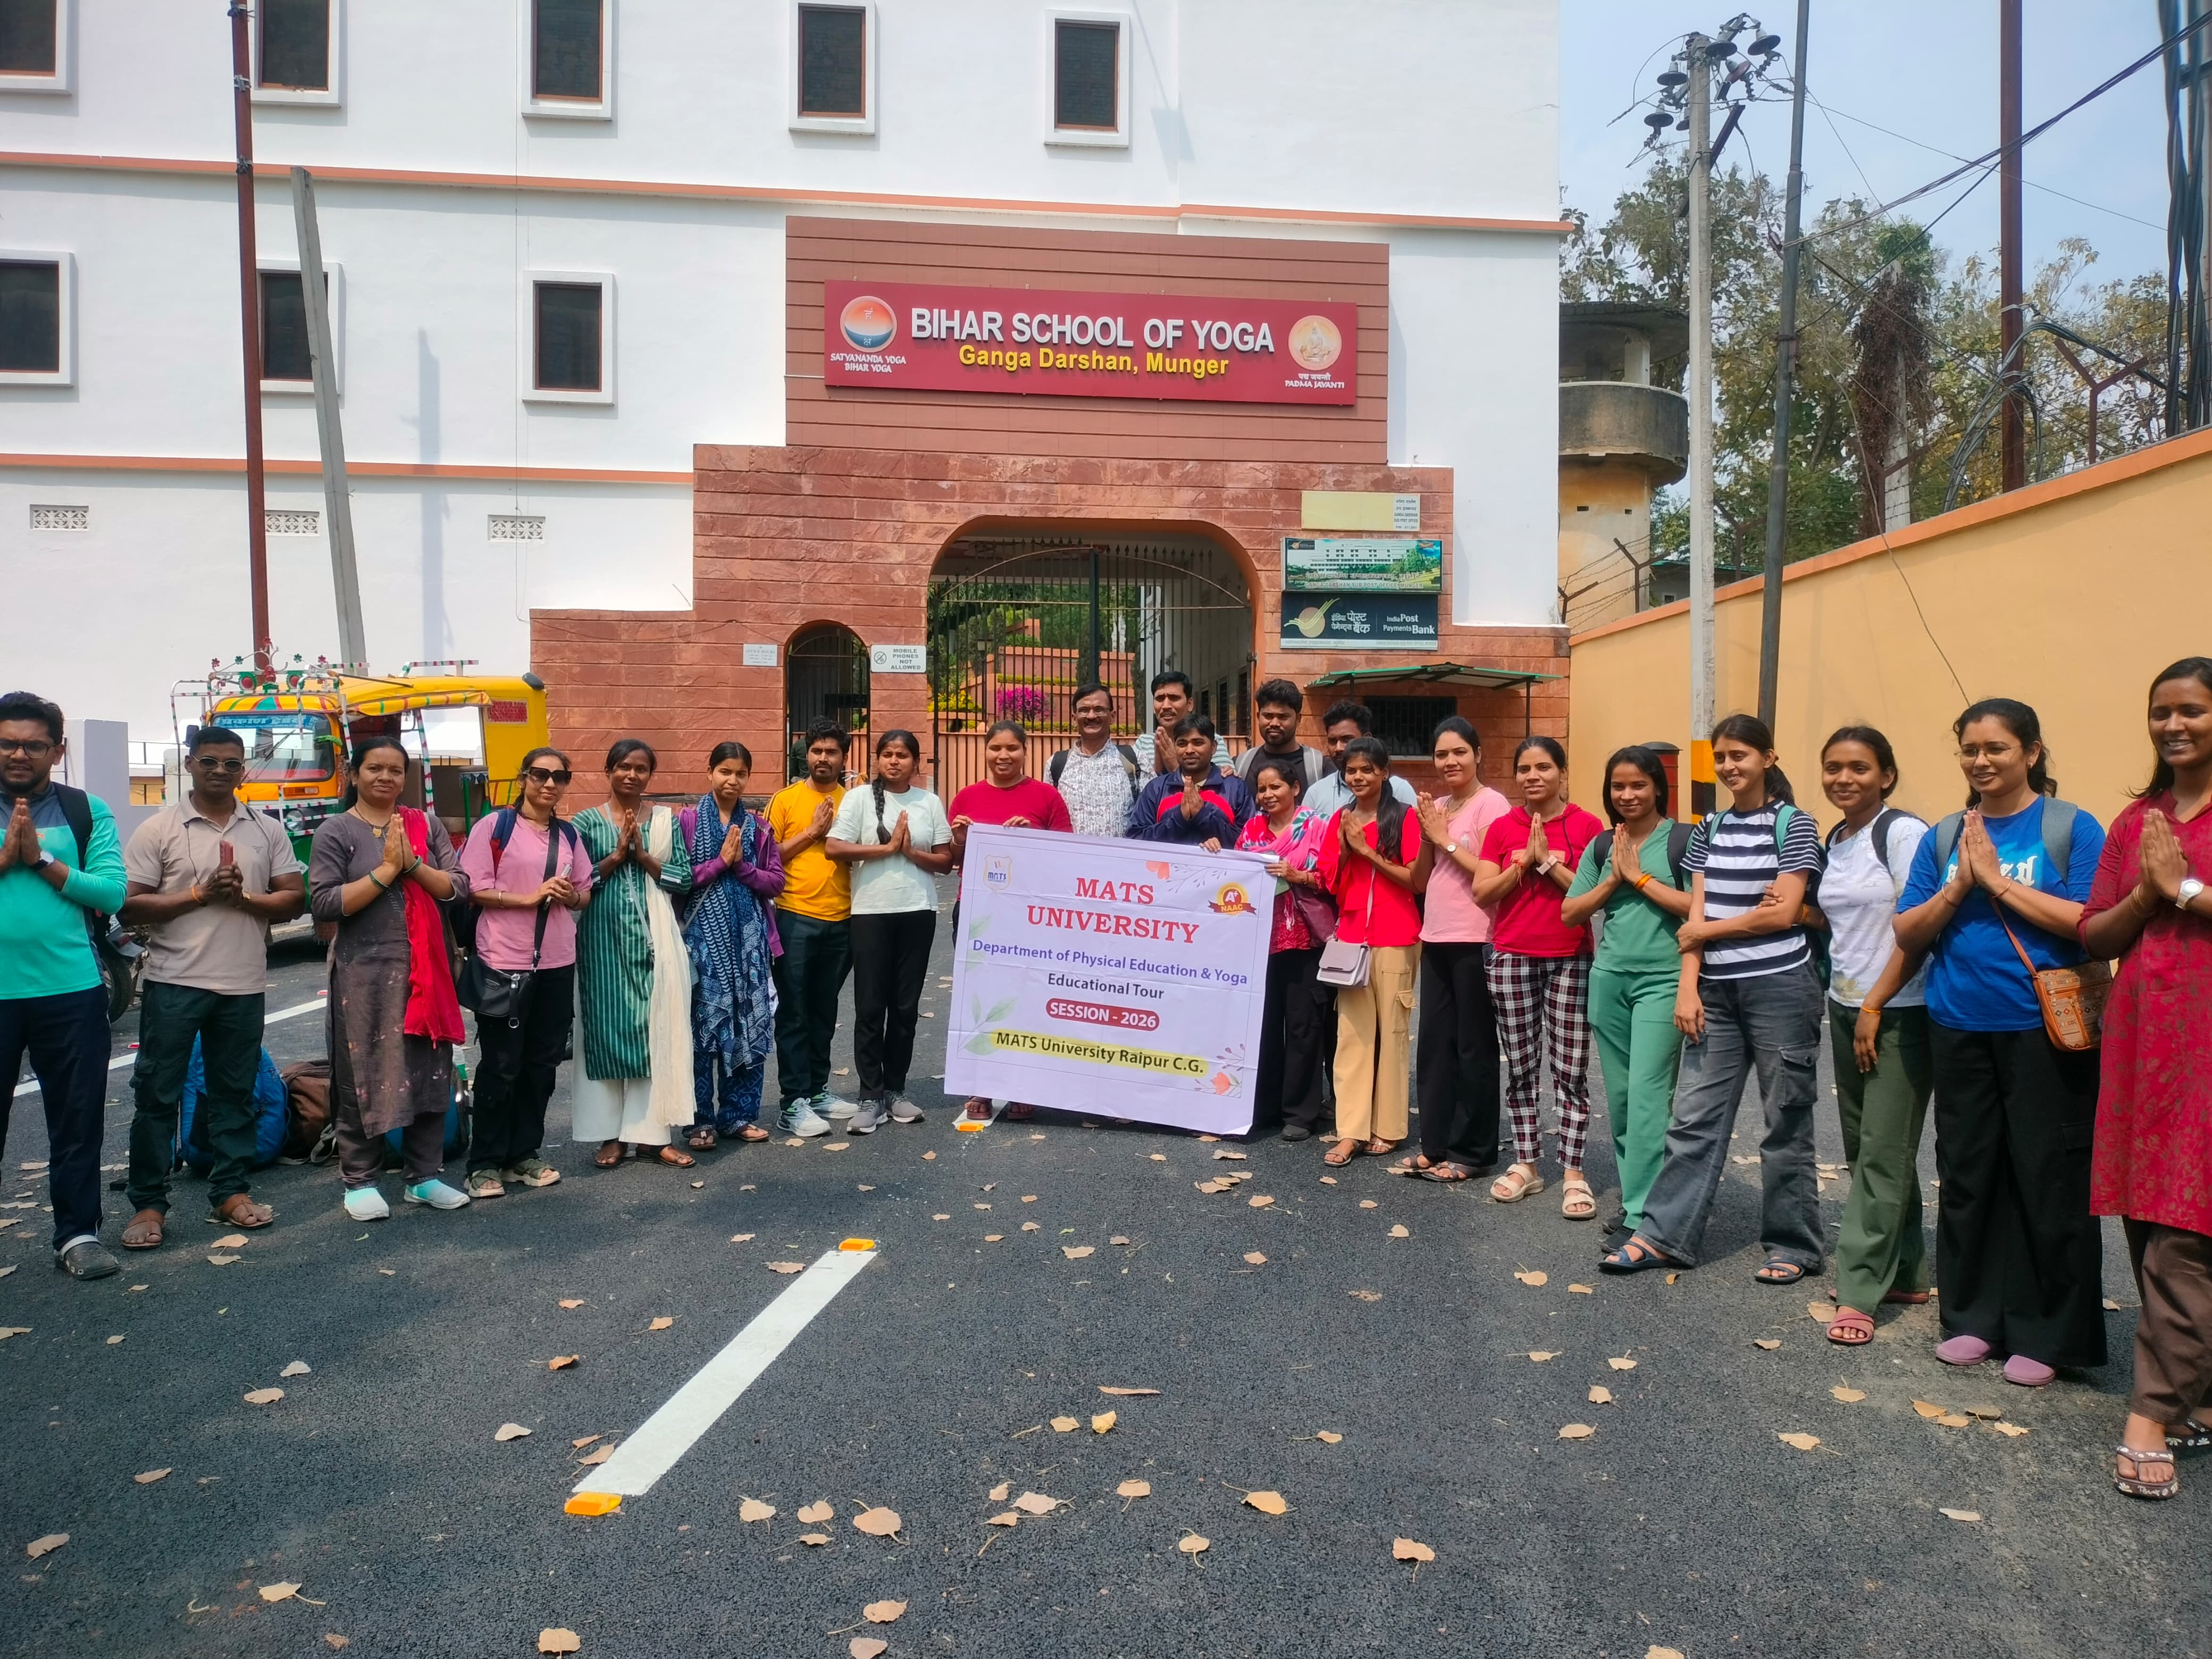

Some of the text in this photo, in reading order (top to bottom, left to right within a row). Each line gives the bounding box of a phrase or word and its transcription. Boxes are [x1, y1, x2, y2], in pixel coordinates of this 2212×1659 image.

[911, 308, 1275, 353] BIHAR SCHOOL OF YOGA
[830, 353, 907, 365] SATYANANDA YOGA
[844, 363, 892, 373] BIHAR YOGA
[959, 345, 1229, 379] Ganga Darshan, Munger
[1412, 625, 1435, 634] Bank
[1075, 877, 1155, 905] MATS
[1225, 891, 1239, 902] A+
[1026, 905, 1200, 944] UNIVERSITY
[973, 939, 1248, 985] Department of Physical Education & Yoga
[1048, 973, 1164, 1000] Educational Tour
[1050, 1001, 1109, 1023] SESSION
[1120, 1012, 1157, 1028] 2026
[996, 1032, 1205, 1073] MATS University Raipur C.G.
